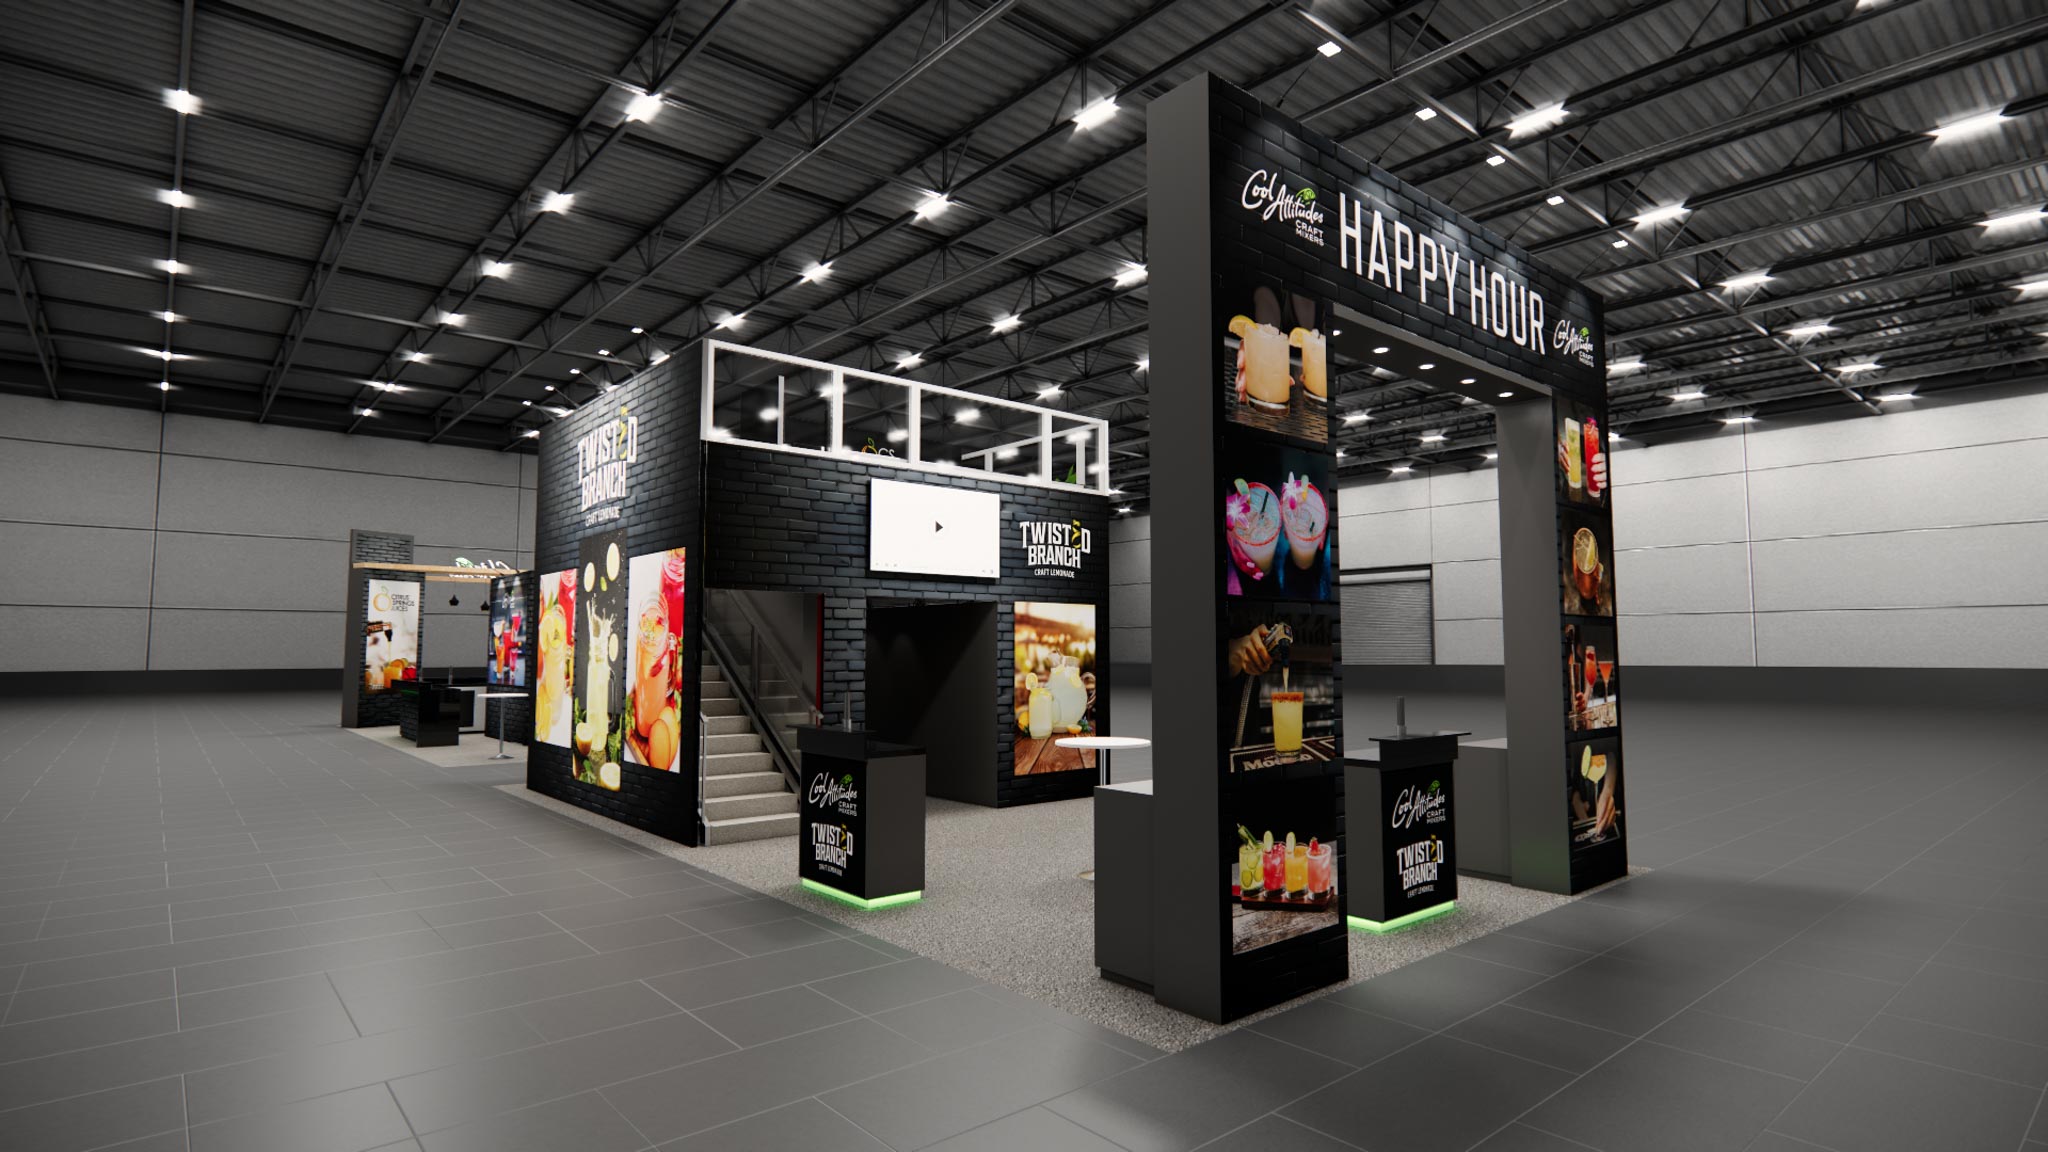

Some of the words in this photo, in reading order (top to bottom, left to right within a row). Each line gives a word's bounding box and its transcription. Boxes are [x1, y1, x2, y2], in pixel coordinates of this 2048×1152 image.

[1242, 169, 1277, 209] Cool
[1263, 184, 1324, 224] Attitudes
[1295, 219, 1324, 238] CRAFT
[1295, 228, 1325, 247] MIXERS
[1339, 192, 1459, 316] HAPPY
[1469, 259, 1546, 356] HOUR
[1553, 319, 1571, 349] Cool
[581, 460, 627, 512] BRANCH
[1027, 544, 1081, 569] BRANCH
[1034, 568, 1050, 576] CRAFT
[1050, 568, 1075, 579] LEMONADE
[808, 772, 829, 804] Cool
[819, 778, 858, 809] Attitudes
[838, 801, 857, 811] CRAFT
[1392, 785, 1416, 829] Cool
[1405, 787, 1446, 829] Attitudes
[1426, 808, 1446, 818] CRAFT
[815, 842, 847, 869] BRANCH
[1402, 861, 1438, 891] BRANCH
